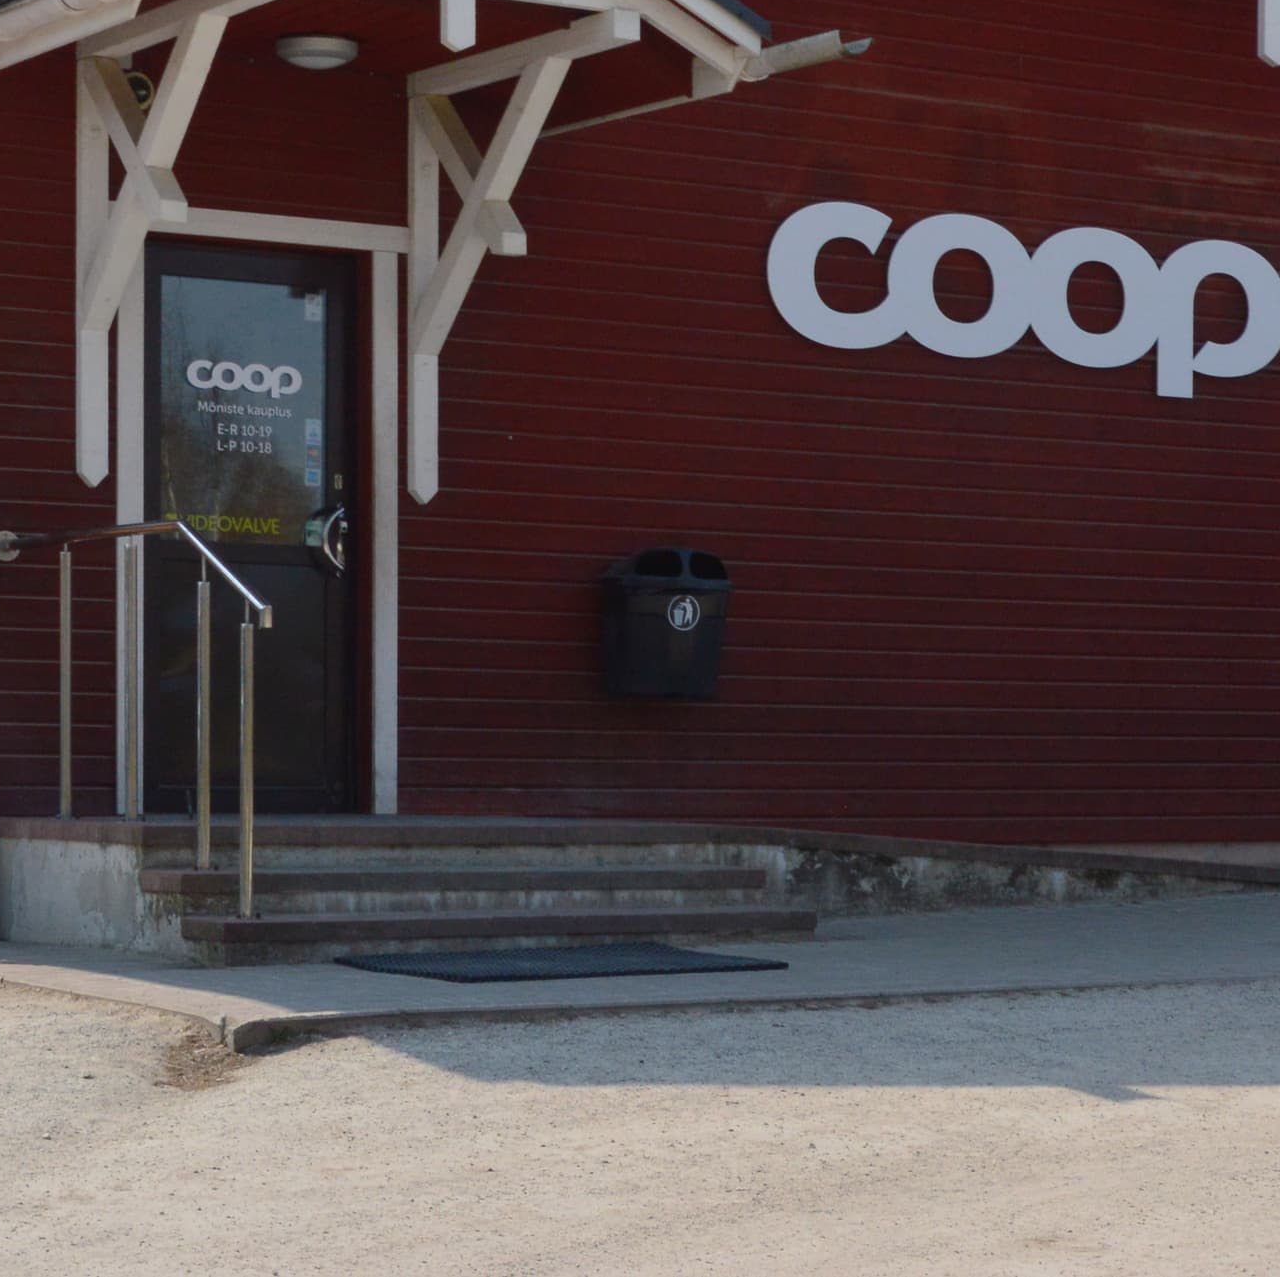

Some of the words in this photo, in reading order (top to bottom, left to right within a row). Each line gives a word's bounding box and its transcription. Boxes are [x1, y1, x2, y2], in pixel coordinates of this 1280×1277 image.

[186, 359, 303, 399] coop
[197, 400, 245, 416] Mõniste
[247, 405, 293, 419] kauplus
[217, 423, 238, 436] E-R
[242, 425, 273, 437] 10-19
[216, 440, 237, 452] L-P
[241, 441, 273, 454] 10-18
